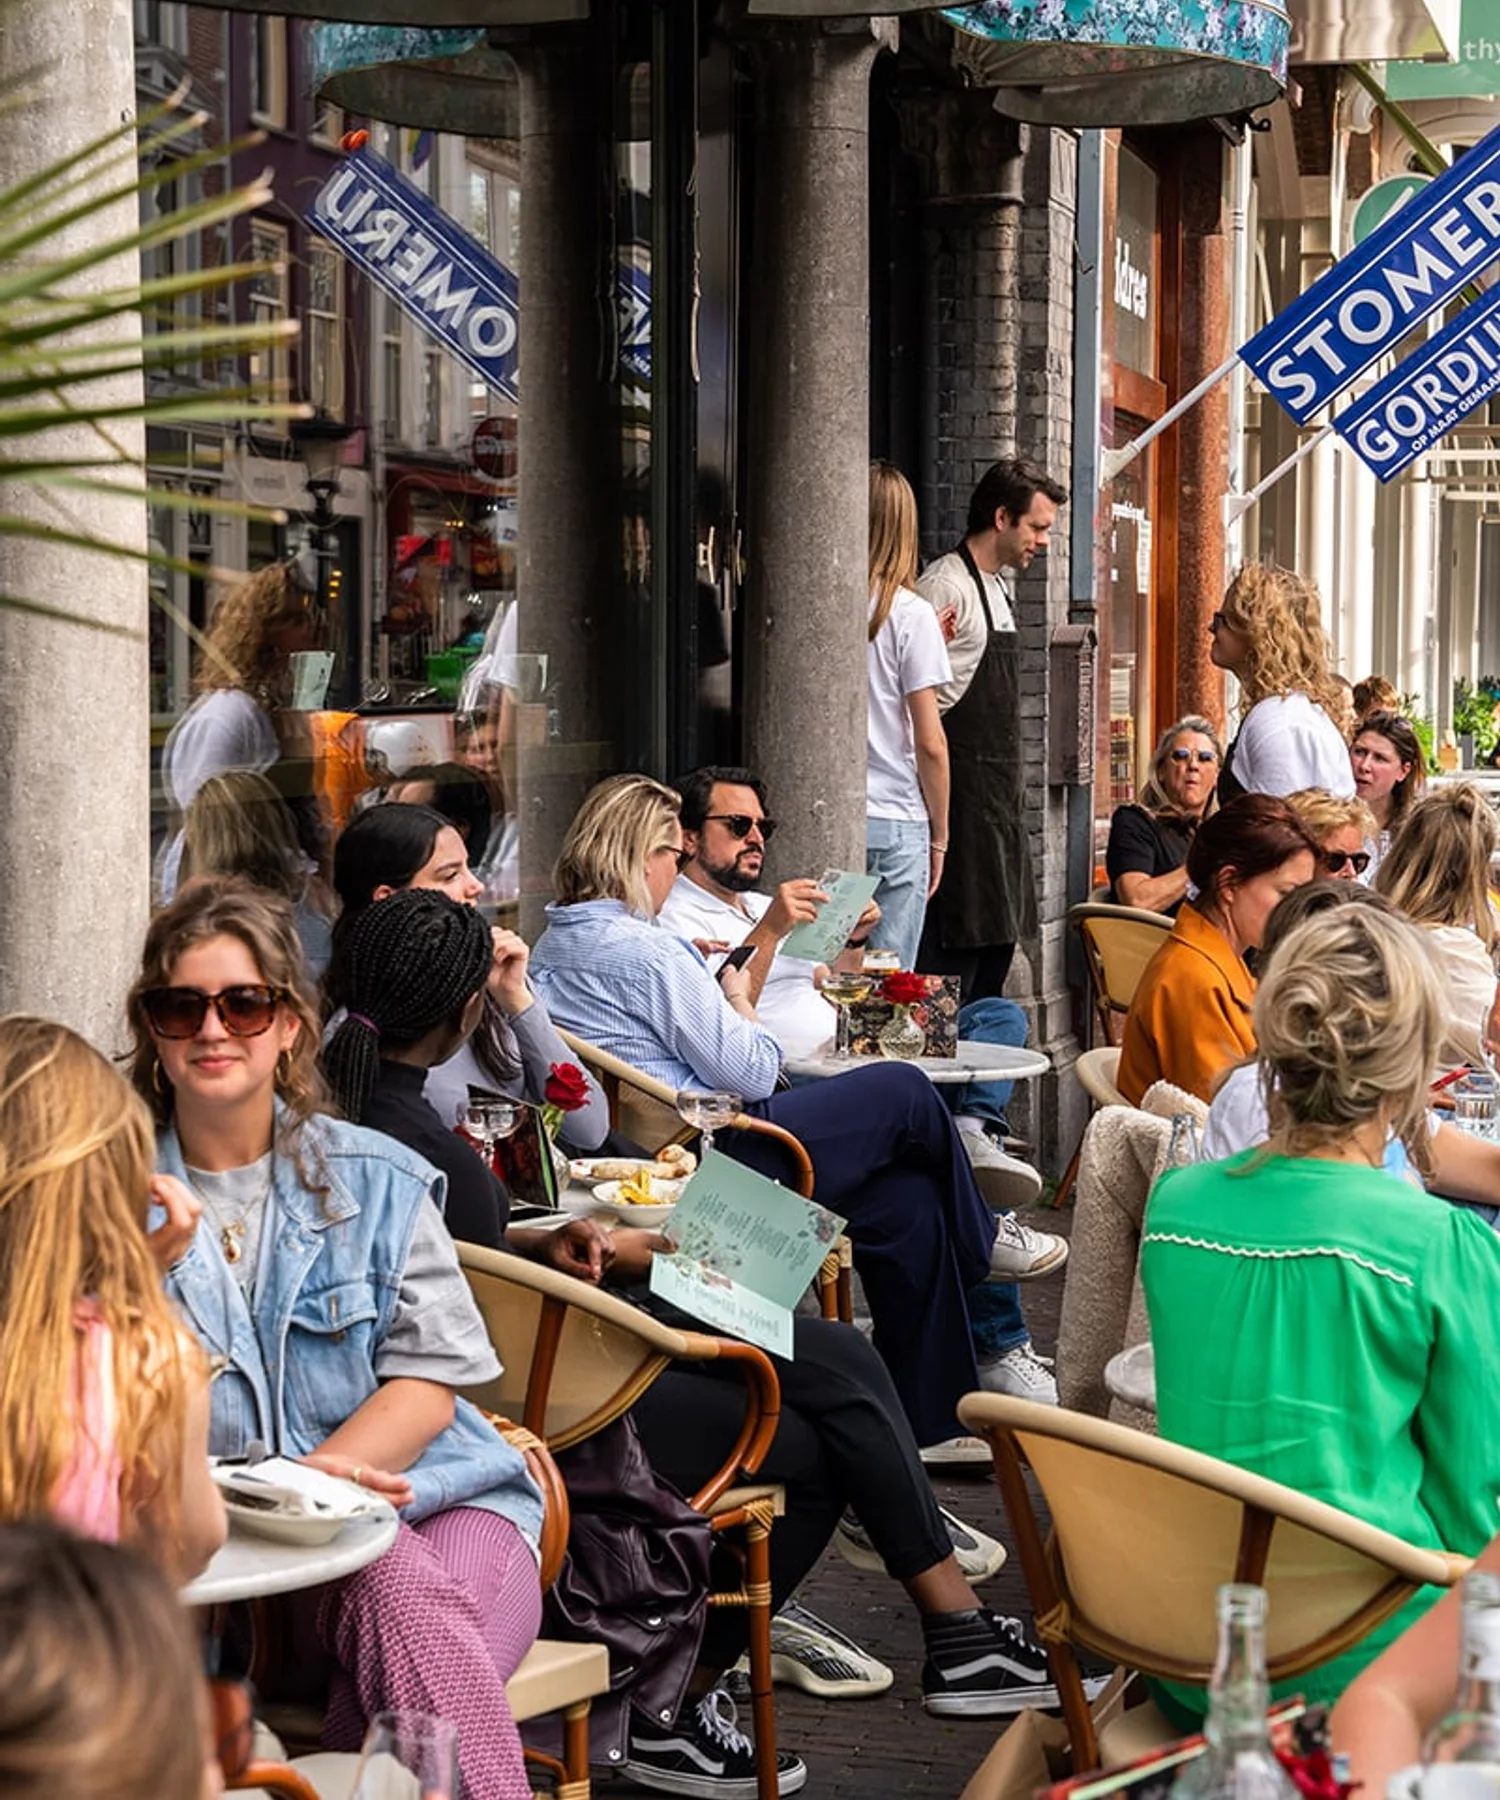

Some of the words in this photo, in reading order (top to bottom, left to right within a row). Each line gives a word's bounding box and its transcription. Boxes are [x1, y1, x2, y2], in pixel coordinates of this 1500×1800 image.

[1357, 312, 1500, 462] GORDIJ
[1411, 434, 1428, 451] OP
[1427, 408, 1459, 438] MAAT
